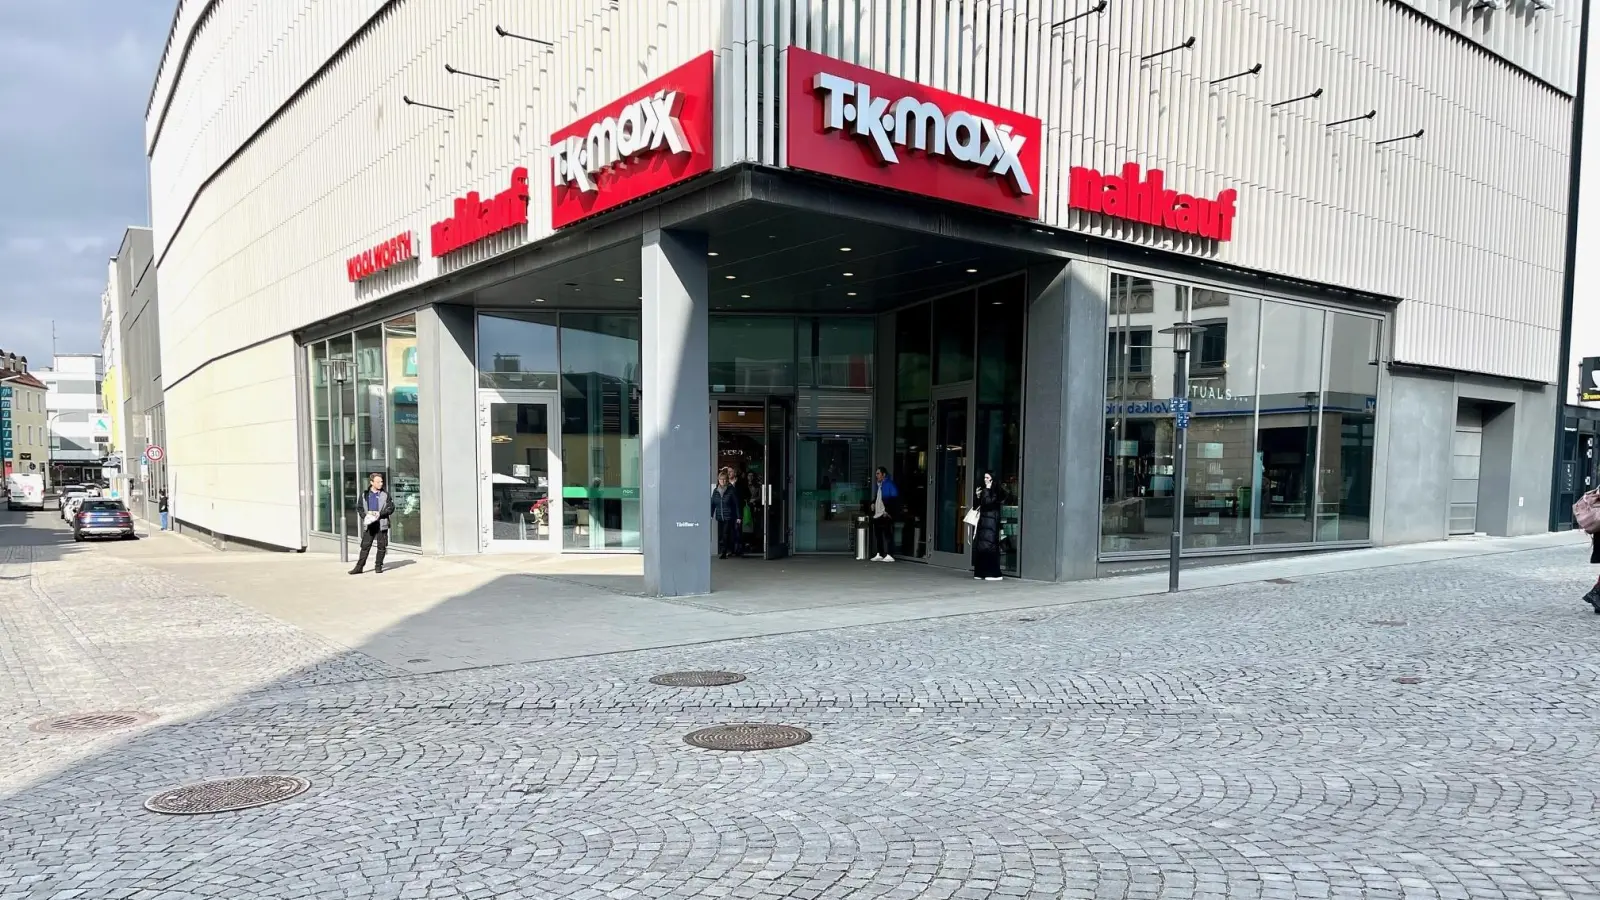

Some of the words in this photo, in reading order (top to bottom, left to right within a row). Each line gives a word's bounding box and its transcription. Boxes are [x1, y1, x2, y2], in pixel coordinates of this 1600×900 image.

[431, 167, 529, 257] nahkauf
[1069, 162, 1237, 241] nahkauf
[347, 230, 411, 282] WOOLWORTH
[1, 400, 11, 457] müller
